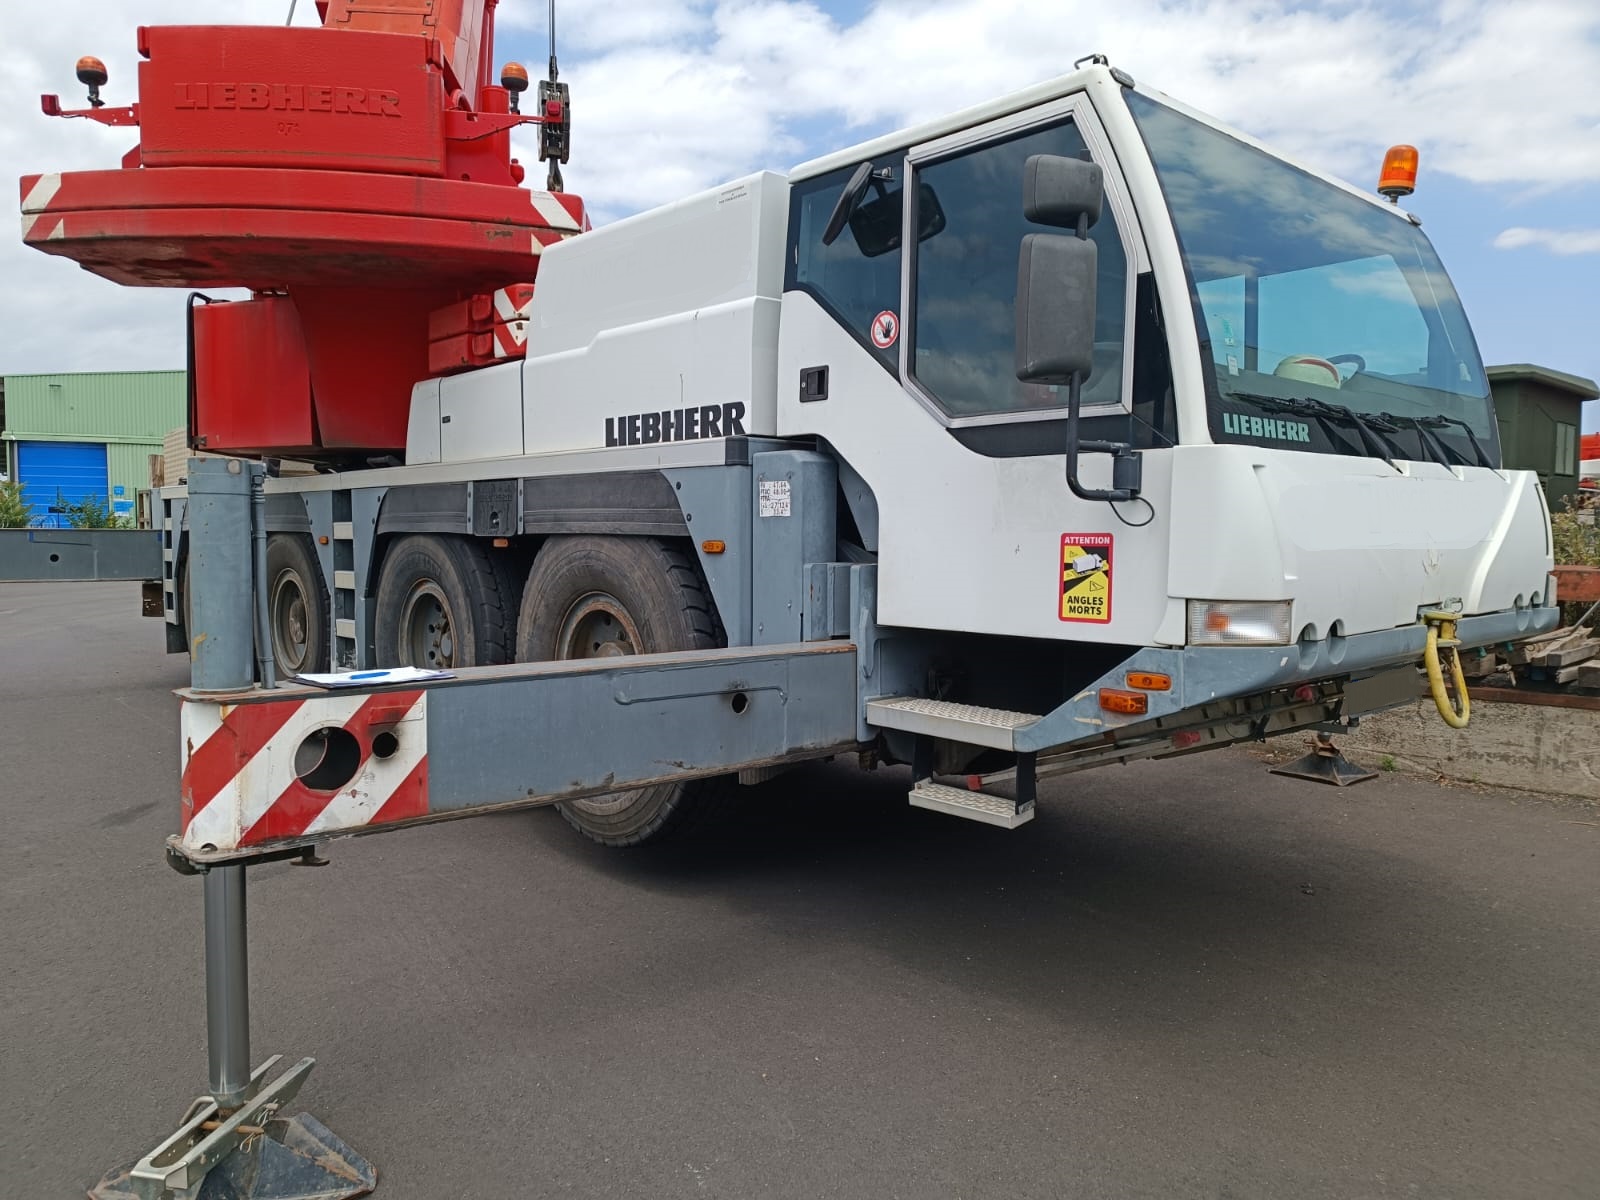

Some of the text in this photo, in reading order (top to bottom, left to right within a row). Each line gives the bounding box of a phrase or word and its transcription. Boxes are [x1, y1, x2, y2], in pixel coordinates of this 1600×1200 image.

[173, 82, 402, 118] LIEBHERR
[605, 401, 746, 447] LIEBHERR
[1223, 413, 1310, 442] LIEBHERR
[1064, 536, 1110, 545] ATTENTION
[1067, 595, 1104, 606] ANGLES
[1068, 605, 1102, 615] MORTS
